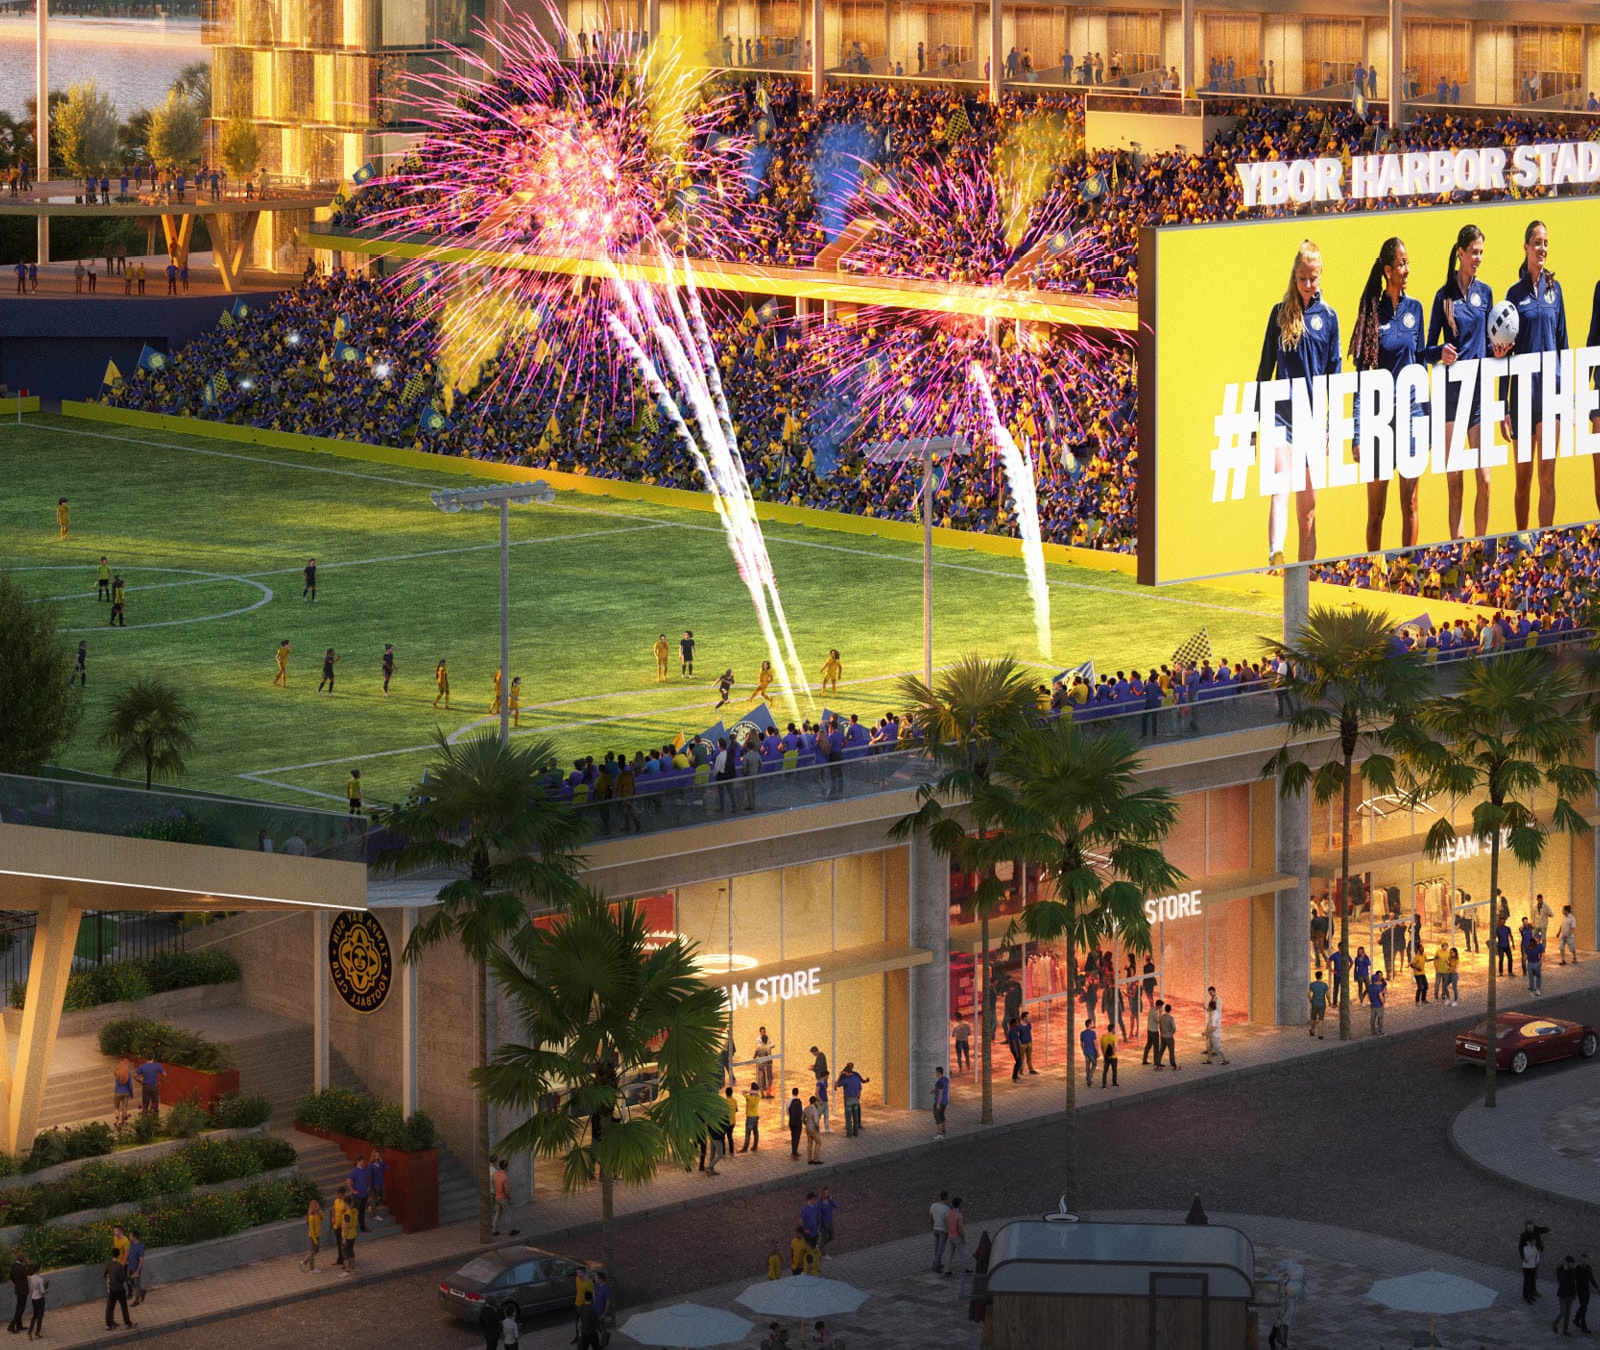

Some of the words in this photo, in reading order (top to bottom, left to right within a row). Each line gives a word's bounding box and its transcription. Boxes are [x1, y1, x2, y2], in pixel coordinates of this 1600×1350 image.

[1235, 157, 1343, 207] YBOR
[1351, 147, 1506, 199] HARBOR
[1144, 889, 1202, 925] STORE
[755, 966, 821, 1006] STORE
